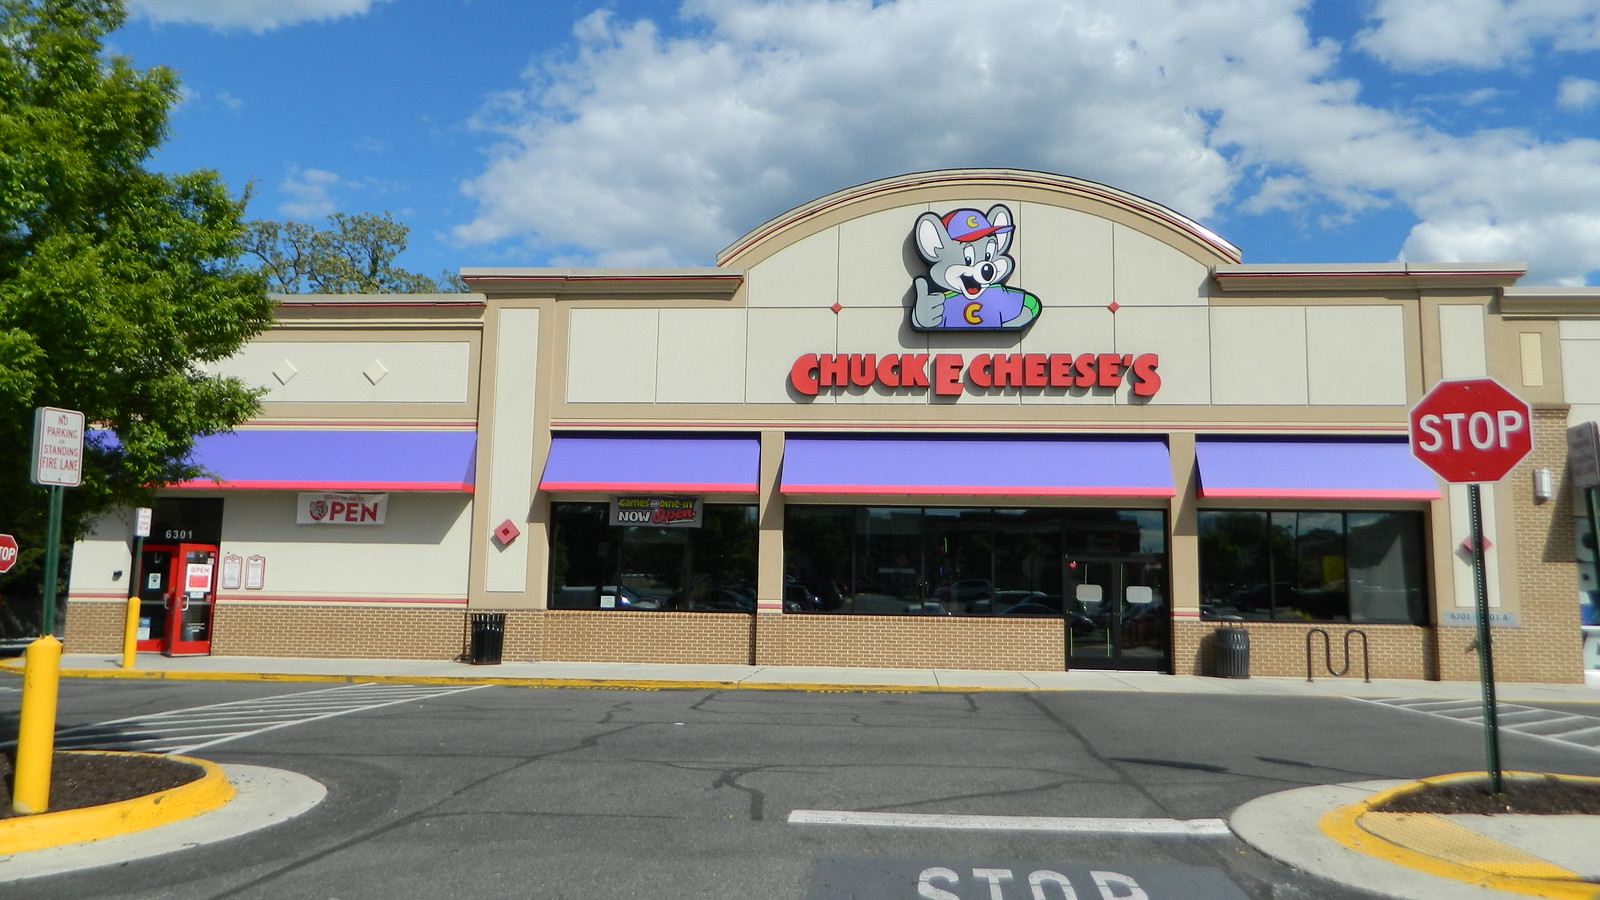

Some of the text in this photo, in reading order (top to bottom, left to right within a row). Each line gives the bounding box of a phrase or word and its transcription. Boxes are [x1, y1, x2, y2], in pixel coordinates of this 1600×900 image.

[963, 302, 983, 324] C
[790, 353, 1161, 397] CHUCK E CHEESE'S
[58, 416, 68, 425] NO
[47, 426, 78, 440] PARKING
[1418, 410, 1523, 452] STOP
[44, 445, 79, 457] STANDING
[42, 457, 78, 471] FIRE LANE
[618, 508, 696, 524] NOW Open
[165, 530, 193, 539] 6301
